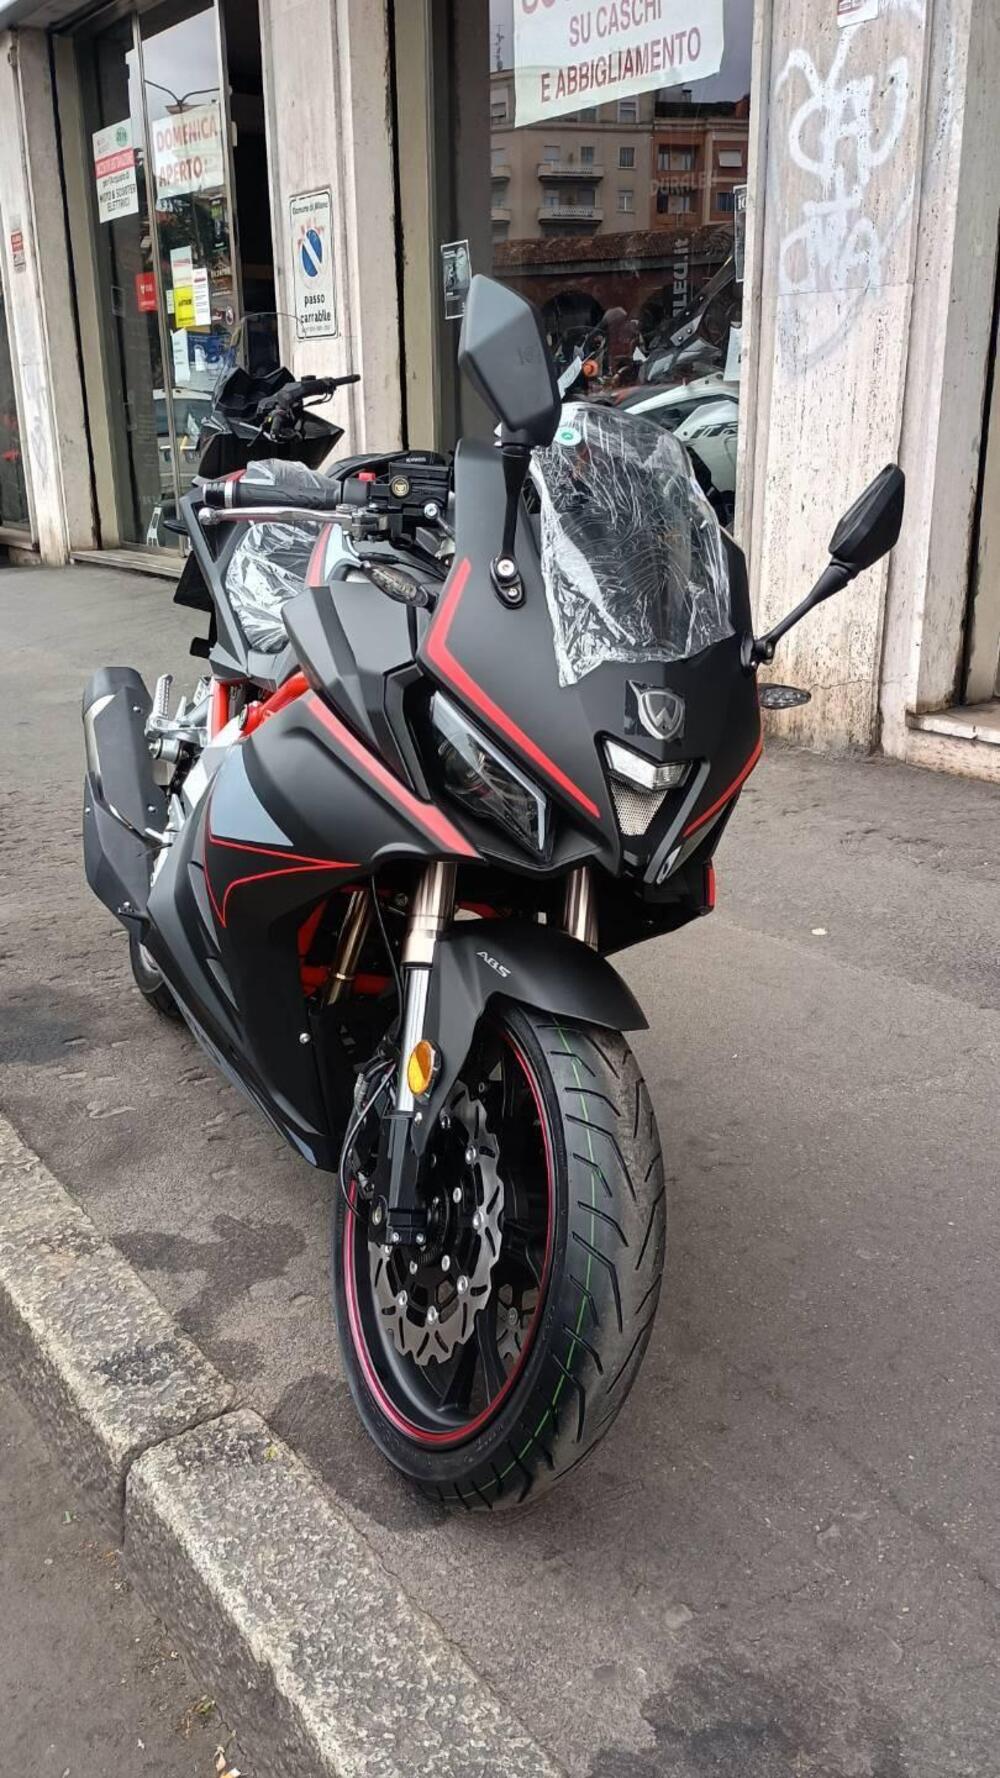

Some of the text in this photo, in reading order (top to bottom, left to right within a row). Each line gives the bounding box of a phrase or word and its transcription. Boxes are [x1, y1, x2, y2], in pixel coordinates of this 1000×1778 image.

[569, 12, 591, 47] SU
[596, 0, 662, 38] CASCHI
[541, 26, 701, 103] E ABBIGLIAMENTO
[156, 116, 218, 152] DOMENICA
[160, 155, 203, 184] APERTO
[304, 293, 326, 308] passo
[300, 309, 332, 324] carrabile
[476, 951, 511, 977] ABS
